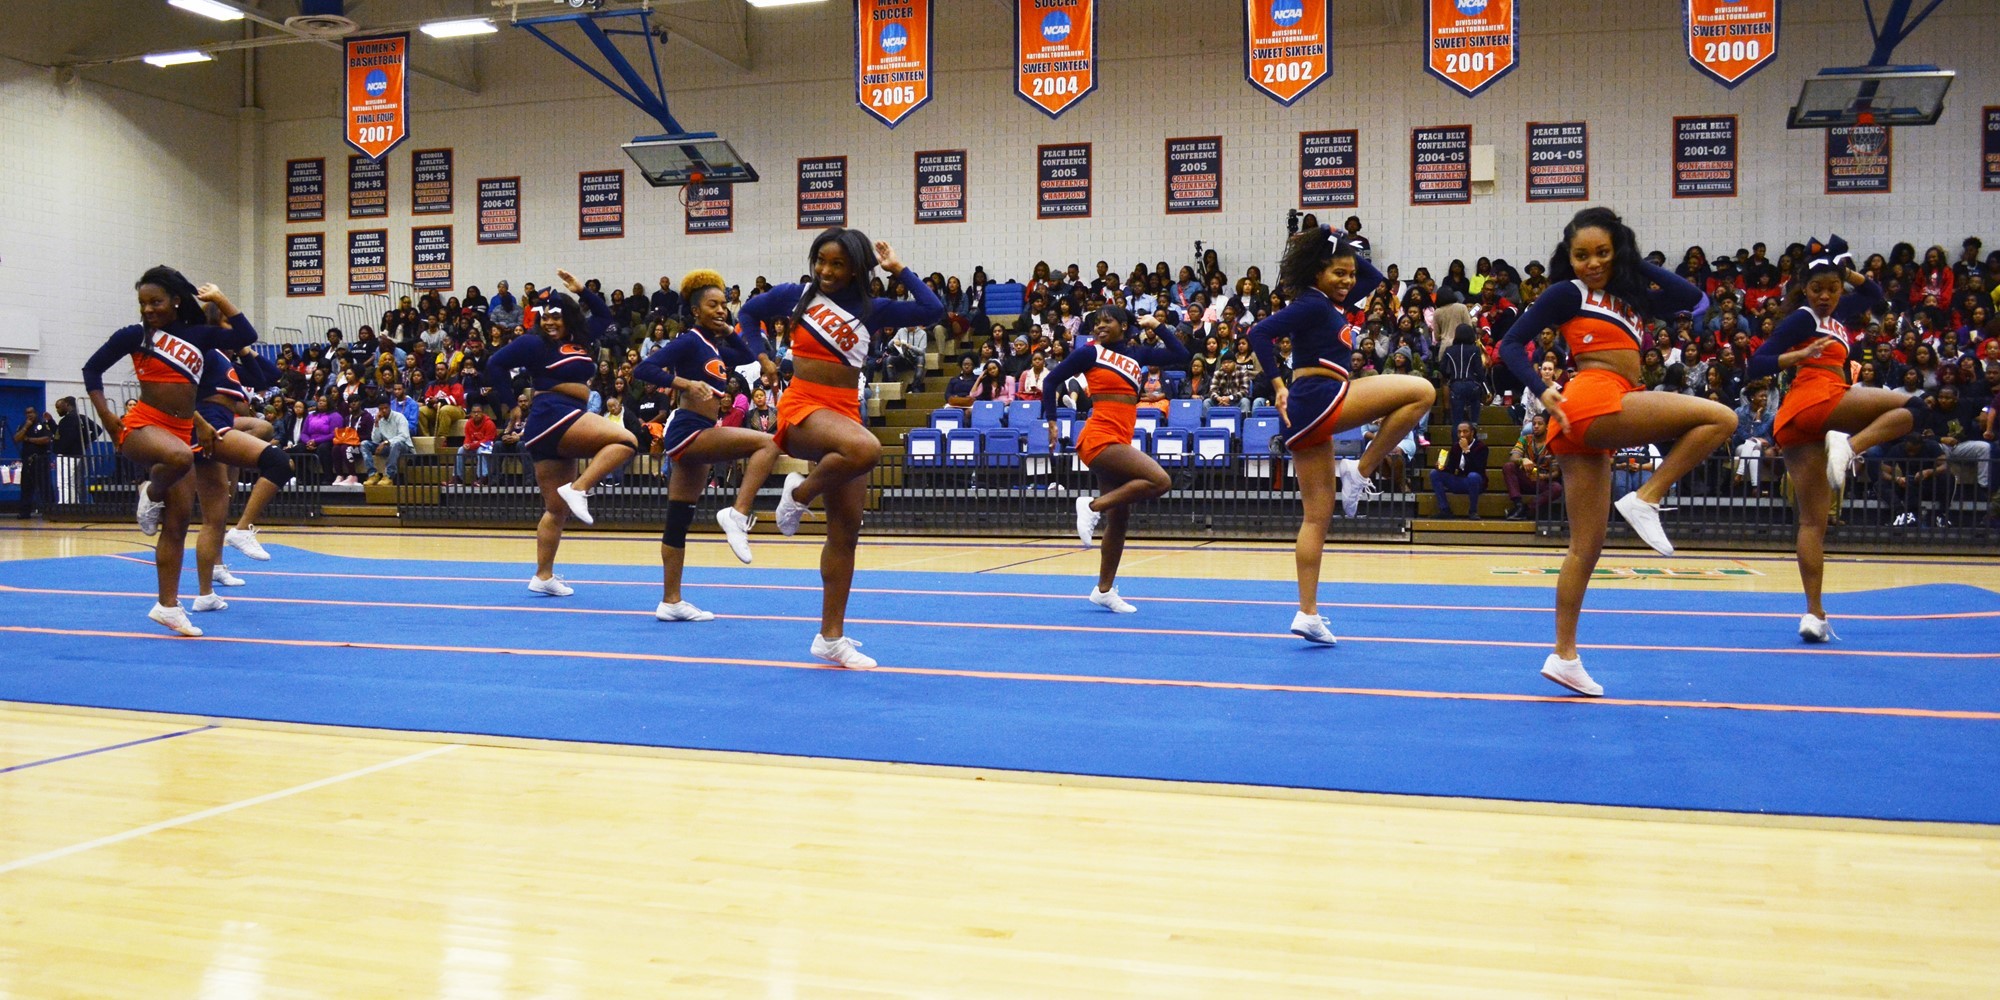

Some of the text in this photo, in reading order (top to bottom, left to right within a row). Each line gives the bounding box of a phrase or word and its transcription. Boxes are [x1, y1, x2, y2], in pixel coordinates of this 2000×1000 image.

[1035, 0, 1077, 8] SOCCER
[1458, 0, 1487, 8] NCAA
[873, 8, 913, 20] SOCCER
[1274, 9, 1302, 20] NCAA
[1726, 12, 1766, 20] TOURNAMENT
[1044, 25, 1070, 35] NCAA
[1466, 24, 1504, 32] TOURNAMENT
[1692, 23, 1772, 37] SWEET SIXTEEN
[883, 36, 906, 47] NCAA
[1282, 34, 1318, 42] TOURNAMENT
[1434, 35, 1509, 49] SWEET SIXTEEN
[357, 43, 396, 54] WOMEN'S
[1253, 44, 1323, 59] SWEET SIXTEEN
[1705, 40, 1759, 62] 2000
[350, 55, 401, 67] BASKETBALL
[1446, 52, 1494, 73] 2001
[1023, 60, 1089, 74] SWEET SIXTEEN
[1264, 61, 1312, 83] 2002
[863, 71, 924, 85] SWEET SIXTEEN
[367, 82, 387, 91] NCAA
[1033, 76, 1078, 96] 2004
[872, 86, 915, 106] 2005
[357, 113, 394, 123] FINAL FOUR
[360, 126, 393, 143] 2007
[1533, 127, 1582, 136] PEACH BELT
[1679, 132, 1731, 140] CONFERENCE
[1306, 136, 1351, 145] PEACH BELT
[1417, 141, 1466, 149] CONFERENCE
[1532, 137, 1583, 145] CONFERENCE
[1043, 150, 1066, 158] PEACH
[1305, 145, 1352, 154] CONFERENCE
[1684, 146, 1726, 156] 2001-02
[1171, 152, 1217, 160] CONFERENCE
[1418, 152, 1465, 162] 2004-05
[1532, 150, 1583, 161] 2004-05
[1042, 158, 1087, 166] CONFERENCE
[1315, 157, 1343, 166] 2005
[1677, 161, 1733, 170] CONFERENCE
[919, 164, 961, 172] CONFERENCE
[1180, 163, 1207, 171] 2005
[1416, 163, 1466, 172] CONFERENCE
[1530, 164, 1585, 174] CONFERENCE
[802, 170, 842, 178] CONFERENCE
[1051, 169, 1077, 178] 2005
[1303, 167, 1355, 177] CONFERENCE
[1415, 172, 1467, 180] TOURNAMENT
[1680, 171, 1730, 180] CHAMPIONS
[418, 173, 445, 181] 1994-95
[584, 176, 603, 184] PEACH
[928, 175, 952, 183] 2005
[1172, 174, 1216, 182] CONFERENCE
[1532, 175, 1582, 184] CHAMPIONS
[354, 180, 381, 188] 1994-95
[583, 183, 620, 191] CONFERENCE
[810, 180, 834, 189] 2005
[1041, 179, 1088, 188] CONFERENCE
[1171, 182, 1217, 190] TOURNAMENT
[1305, 180, 1352, 190] CHAMPIONS
[1420, 181, 1462, 189] CHAMPIONS
[292, 185, 318, 193] 1993-94
[699, 187, 719, 196] 2006
[920, 185, 961, 193] CONFERENCE
[585, 193, 618, 202] 2006-07
[800, 191, 844, 200] CONFERENCE
[919, 193, 961, 201] TOURNAMENT
[1043, 191, 1086, 200] CHAMPIONS
[1174, 190, 1214, 199] CHAMPIONS
[483, 200, 515, 208] 2006-07
[802, 202, 842, 211] CHAMPIONS
[922, 200, 958, 208] CHAMPIONS
[482, 209, 516, 217] CONFERENCE
[582, 205, 621, 214] CONFERENCE
[584, 214, 620, 223] CHAMPIONS
[484, 223, 514, 231] CHAMPIONS
[354, 256, 381, 265] 1996-97
[418, 253, 445, 261] 1996-97
[292, 259, 318, 268] 1996-97
[806, 303, 859, 351] AKERS
[155, 333, 203, 376] AKERS
